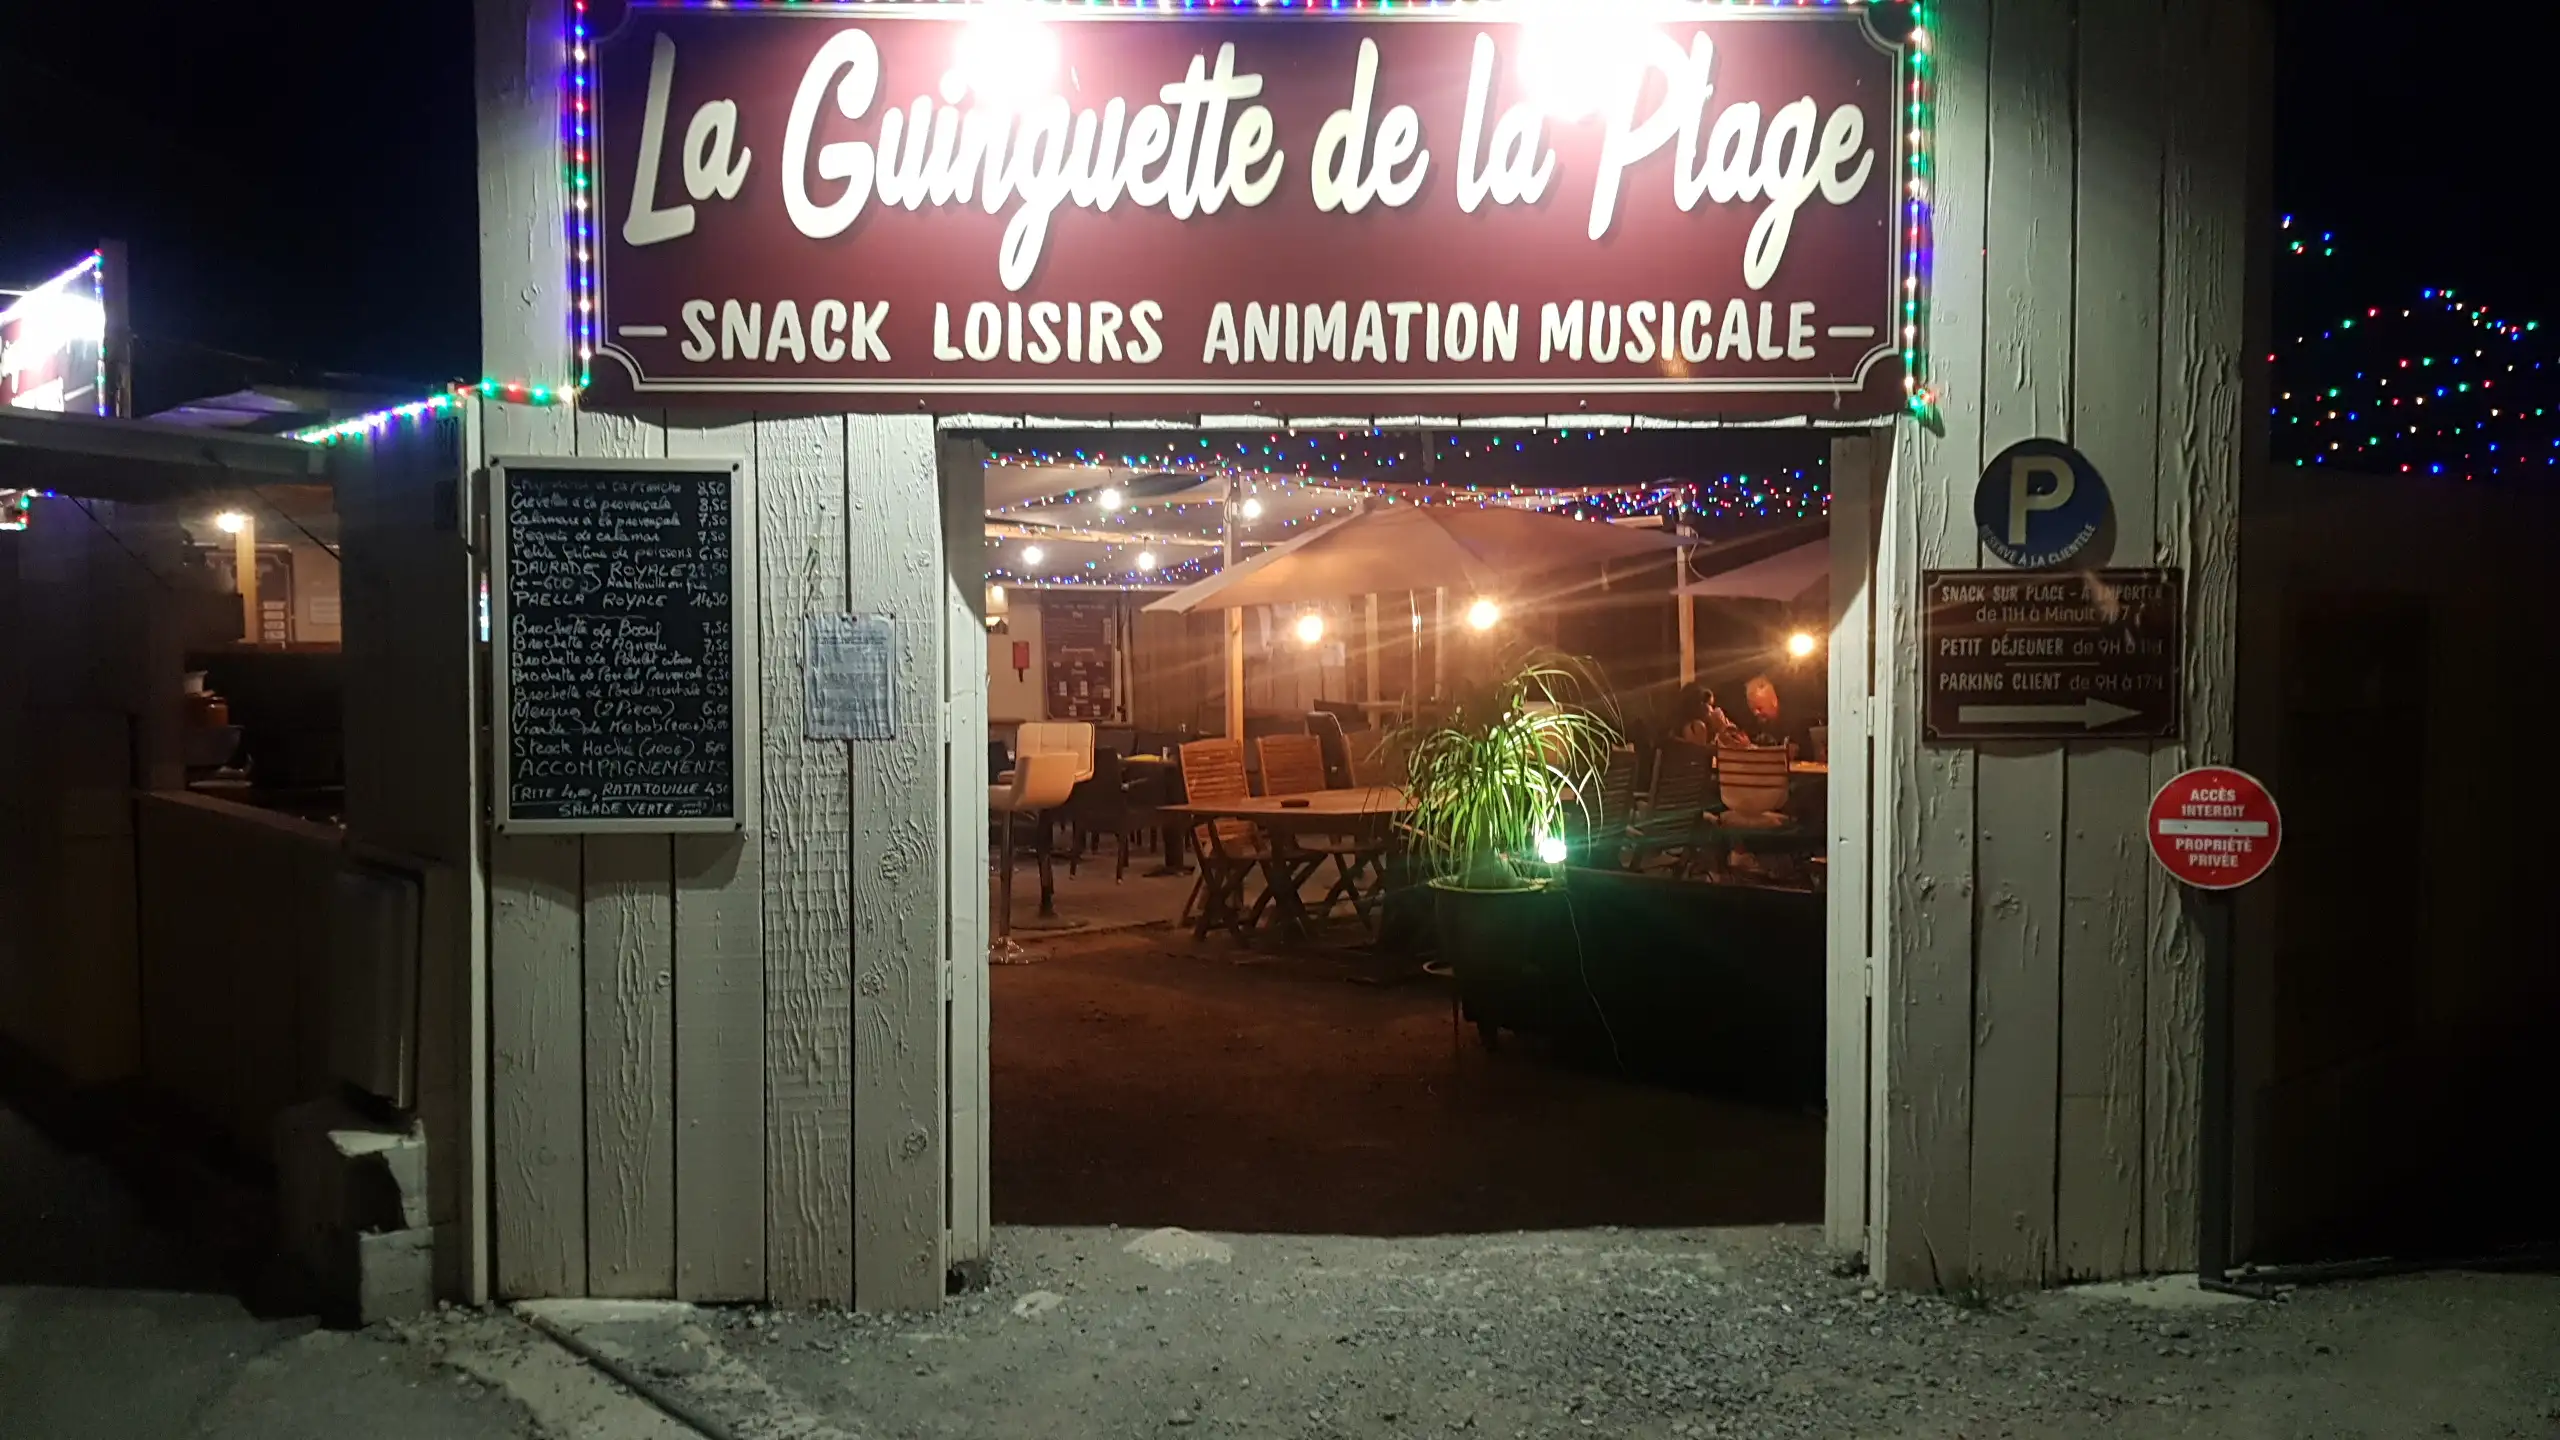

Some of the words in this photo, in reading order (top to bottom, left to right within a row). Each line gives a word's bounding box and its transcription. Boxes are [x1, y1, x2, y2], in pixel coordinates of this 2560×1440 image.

[623, 31, 751, 246] La
[782, 27, 1284, 292] Guinguette
[1311, 37, 1430, 214] de
[1456, 31, 1556, 214] la
[1588, 26, 1875, 290] Plage
[680, 299, 891, 363] SNACK
[933, 299, 1163, 364] LOISIRS
[1202, 300, 1520, 363] ANIMATION
[1539, 297, 1816, 364] MUSICALE
[2008, 456, 2075, 545] P
[609, 560, 687, 582] ROYALE
[512, 591, 585, 608] PAELLA
[602, 591, 668, 612] ROYALE
[1941, 584, 1985, 602] SNACK
[1992, 584, 2019, 602] SUR
[2026, 584, 2066, 602] PLACE
[1975, 605, 1998, 623] de
[2045, 604, 2096, 623] Minuit
[1940, 637, 1983, 657] PETIT
[1991, 633, 2065, 657] DÉJEUNER
[2073, 638, 2094, 656] de
[2098, 637, 2121, 656] 9H
[1939, 671, 2004, 692] PARKING
[2012, 671, 2061, 691] CLIENT
[2069, 673, 2091, 691] de
[2095, 673, 2118, 692] 9H
[518, 757, 730, 779] ACCOMPAGNEMENTS
[2190, 786, 2236, 802] ACCÈS
[558, 800, 622, 817] SALADE
[2181, 803, 2246, 817] INTERDIT
[2175, 837, 2253, 852] PROPRIÉTÉ
[2188, 852, 2239, 868] PRIVÉE
